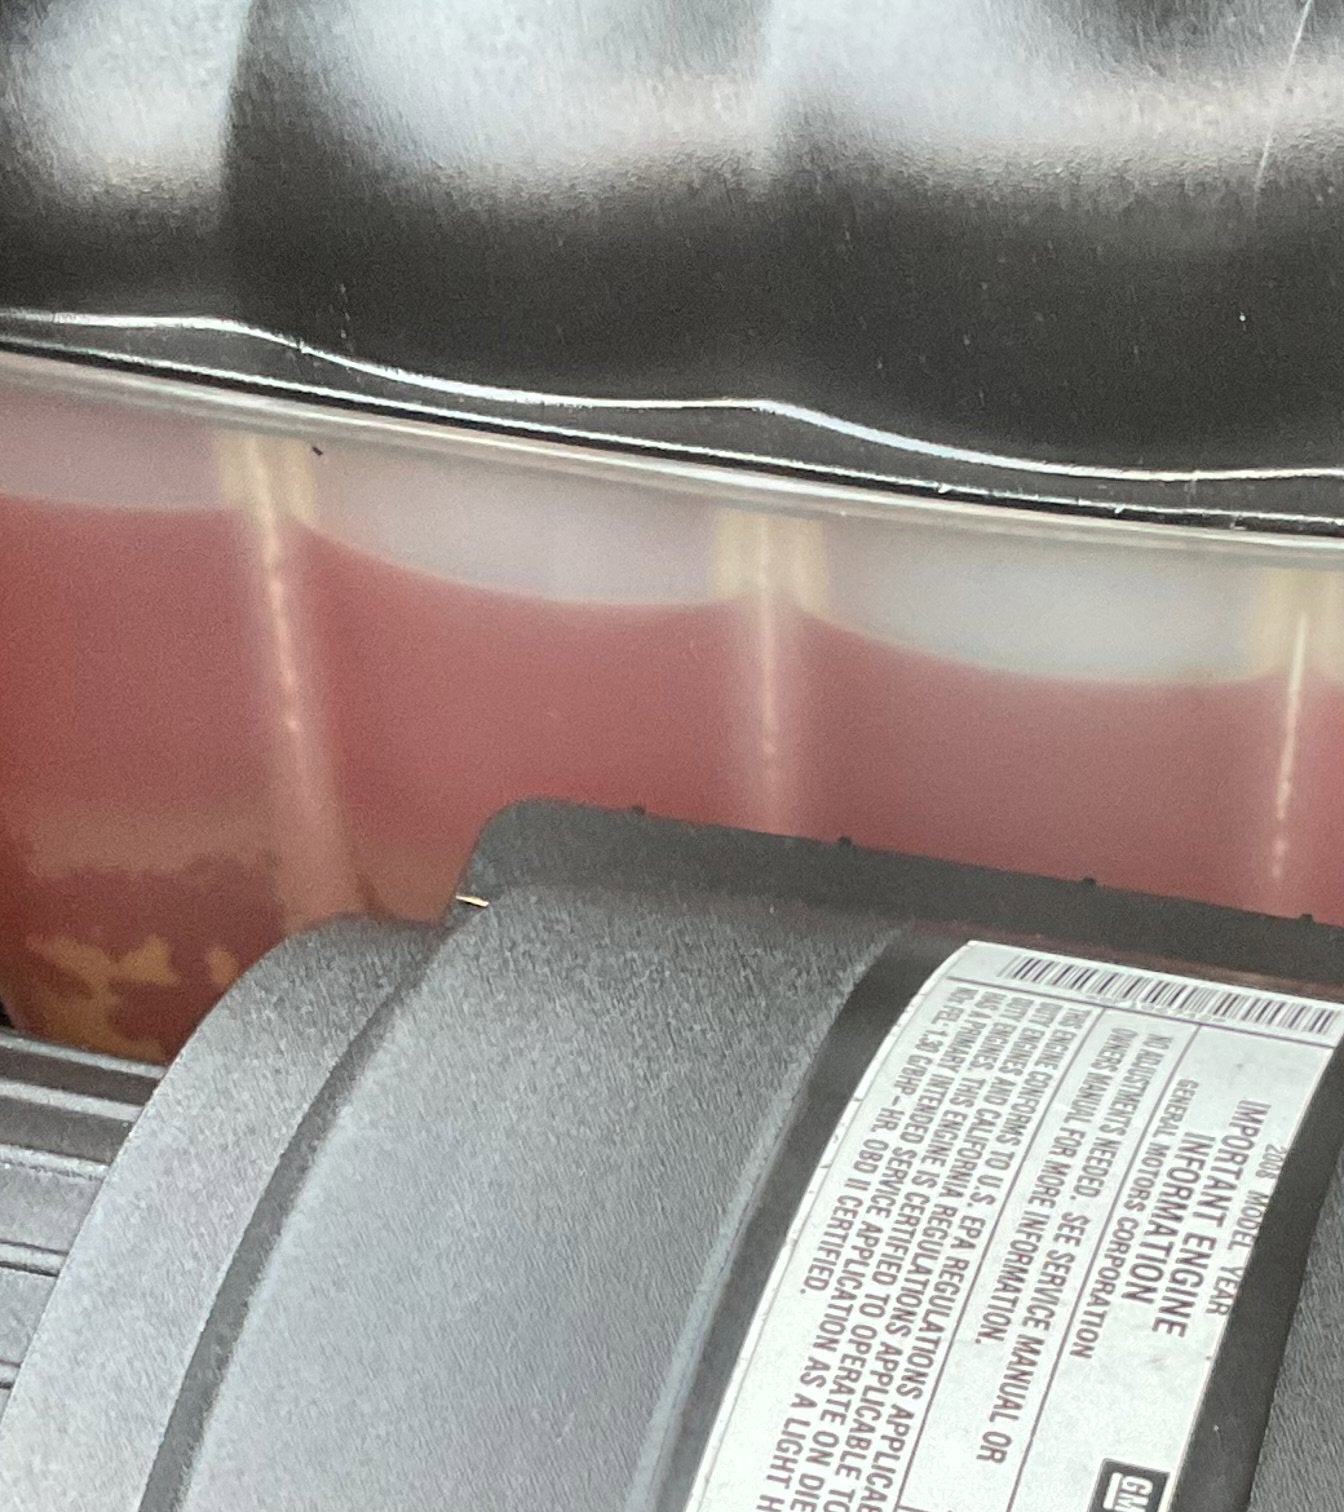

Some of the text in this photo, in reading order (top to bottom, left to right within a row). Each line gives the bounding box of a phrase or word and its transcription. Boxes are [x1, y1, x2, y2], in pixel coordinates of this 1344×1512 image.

[966, 1009, 992, 1021] A
[973, 989, 1007, 1011] HAS
[1057, 1007, 1091, 1031] THIS
[936, 1019, 987, 1073] PRIMARY
[966, 1021, 1017, 1071] ENGINES.
[996, 1027, 1045, 1076] ENGINES
[1032, 1028, 1077, 1070] ENGINE
[897, 1072, 955, 1145] INTENDED
[947, 1076, 986, 1109] THIS
[981, 1076, 1017, 1106] AND
[993, 1069, 1053, 1147] CONFORMS
[1097, 1048, 1164, 1137] ADJUSTMENTS
[851, 1137, 889, 1175] OBD
[919, 1108, 968, 1168] ENGINE
[937, 1106, 1002, 1199] CALIFORNIA
[983, 1148, 1015, 1171] TO
[843, 1176, 871, 1192] II
[864, 1145, 918, 1219] SERVICE
[909, 1168, 941, 1190] IS
[966, 1172, 1004, 1207] U.S.
[972, 1026, 1138, 1343] OWNERS MANUAL FOR MORE INFORMATION.
[1068, 1135, 1122, 1200] NEEDED.
[798, 1193, 863, 1293] CERTIFIED.
[869, 1190, 932, 1287] CERTIFIED
[948, 1213, 987, 1251] EPA
[1051, 1210, 1091, 1247] SEE
[1068, 1077, 1199, 1360] GENERAL MOTORS CORPORATION
[1120, 1131, 1215, 1305] INFORMATION
[1150, 1099, 1272, 1338] IMPORTANT ENGINE
[1226, 1189, 1270, 1252] MODEL
[811, 1220, 884, 1352] APPLICATION
[882, 1202, 958, 1339] REGULATIONS
[1020, 1248, 1076, 1331] SERVICE
[1204, 1264, 1244, 1316] YEAR
[856, 1291, 891, 1321] TO
[894, 1255, 970, 1401] REGULATIONS
[797, 1356, 832, 1389] AS
[818, 1322, 879, 1427] OPERATE
[987, 1333, 1045, 1427] MANUAL
[789, 1392, 819, 1412] A
[833, 1341, 904, 1481] APPLICABLE
[764, 1416, 811, 1489] LIGHT
[804, 1428, 840, 1468] ON
[974, 1429, 1013, 1466] OR
